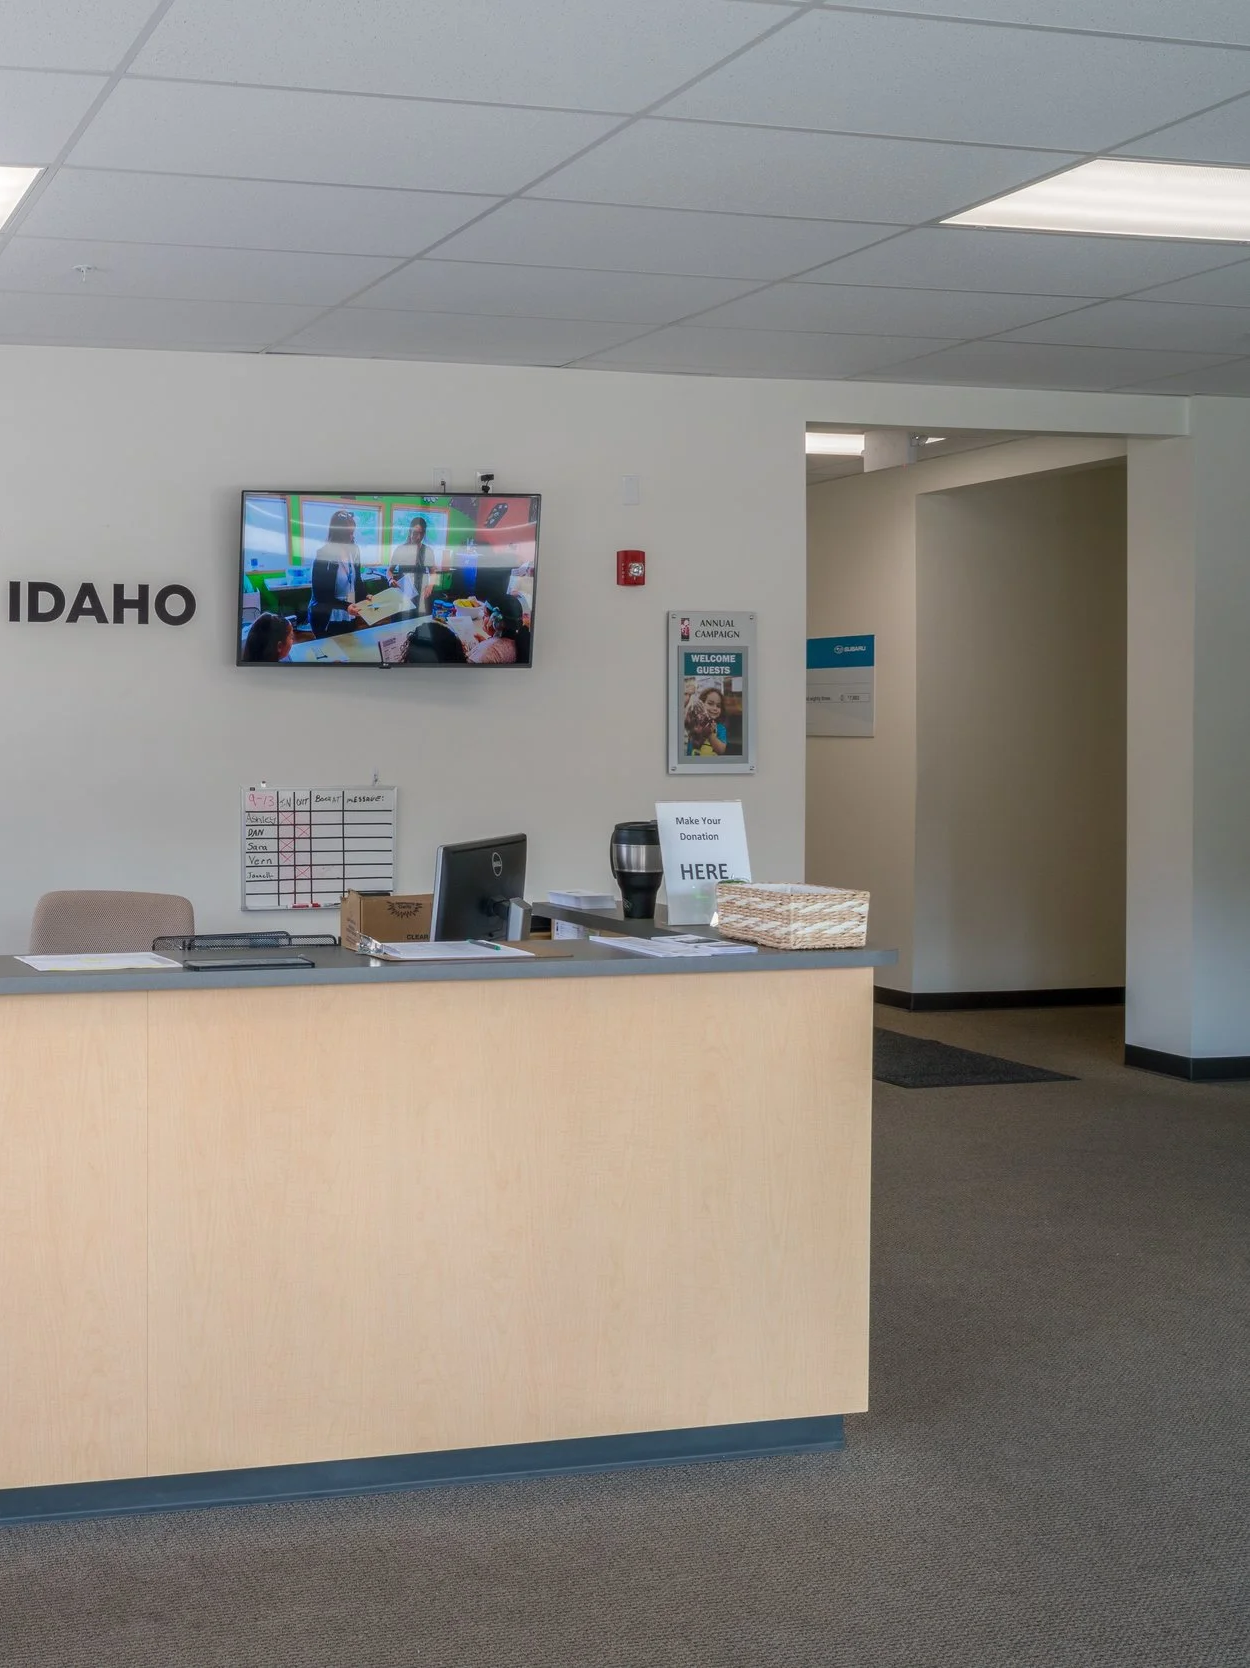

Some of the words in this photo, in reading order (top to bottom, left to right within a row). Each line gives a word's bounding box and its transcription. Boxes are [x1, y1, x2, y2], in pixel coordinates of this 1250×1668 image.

[8, 580, 197, 626] IDAHO
[699, 619, 735, 628] ANNUAL
[694, 630, 740, 639] CAMPAIGN
[691, 654, 736, 664] WELCOME
[696, 666, 731, 675] GUESTS
[246, 813, 277, 825] Ashley
[675, 816, 700, 825] Make
[701, 817, 721, 825] Your
[247, 828, 265, 837] DAN
[680, 832, 719, 841] Donation
[247, 842, 268, 851] Sara
[248, 855, 273, 866] Vern
[680, 863, 729, 880] HERE
